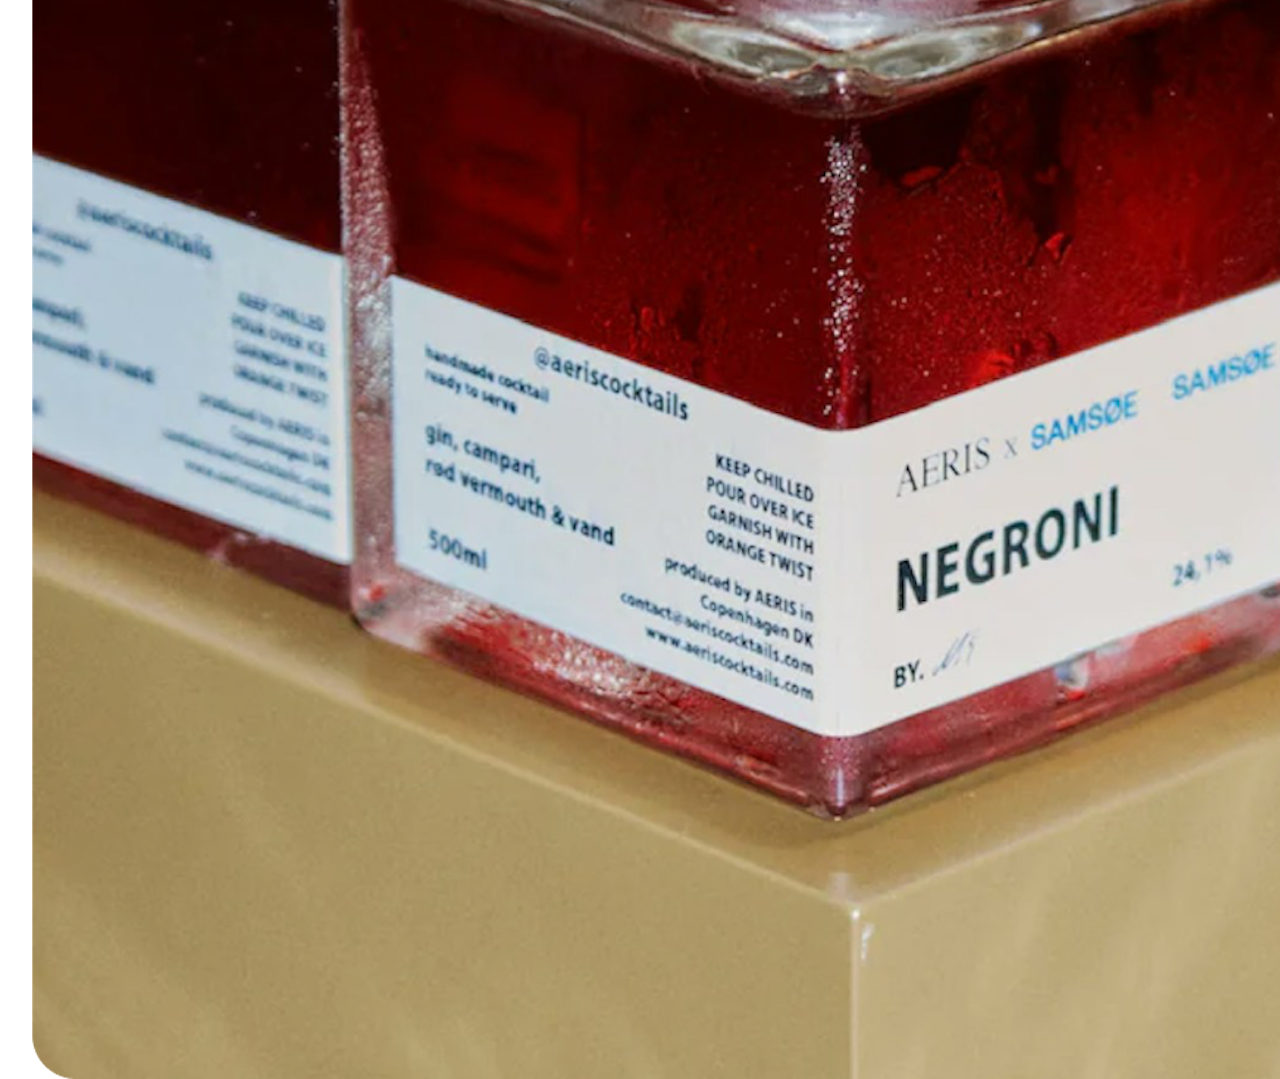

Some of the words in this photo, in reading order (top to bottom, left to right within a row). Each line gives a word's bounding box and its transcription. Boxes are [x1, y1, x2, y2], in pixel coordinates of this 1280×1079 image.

[424, 344, 494, 384] handmade
[499, 373, 550, 404] cocktail
[424, 368, 461, 397] ready
[465, 383, 478, 397] to
[482, 392, 518, 415] serve
[534, 345, 689, 421] @aeriscocktails
[895, 437, 991, 498] AERIS
[1030, 390, 1138, 451] SAMSØE
[1172, 343, 1275, 400] SAMSØE
[425, 424, 459, 452] gin,
[463, 438, 541, 484] campari,
[715, 454, 751, 479] KEEP
[754, 467, 814, 502] CHILLED
[461, 473, 546, 520] vermouth
[551, 505, 566, 527] &
[569, 514, 615, 546] vand
[706, 476, 746, 506] POUR
[749, 491, 788, 520] OVER
[792, 508, 814, 529] ICE
[707, 504, 772, 541] GARNISH
[775, 528, 814, 555] WITH
[428, 529, 488, 571] 500ml
[705, 529, 766, 565] ORANGE
[769, 550, 814, 581] TWIST
[897, 485, 1119, 613] NEGRONI
[664, 556, 730, 593] produced
[734, 577, 751, 602] by
[755, 587, 796, 617] AERIS
[799, 603, 814, 621] in
[620, 590, 814, 675] contact@aeriscocktails.com
[700, 594, 790, 642] Copenhagen
[793, 627, 814, 649] DK
[645, 627, 814, 701] www.aeriscocktails.com
[893, 660, 924, 689] BY.
